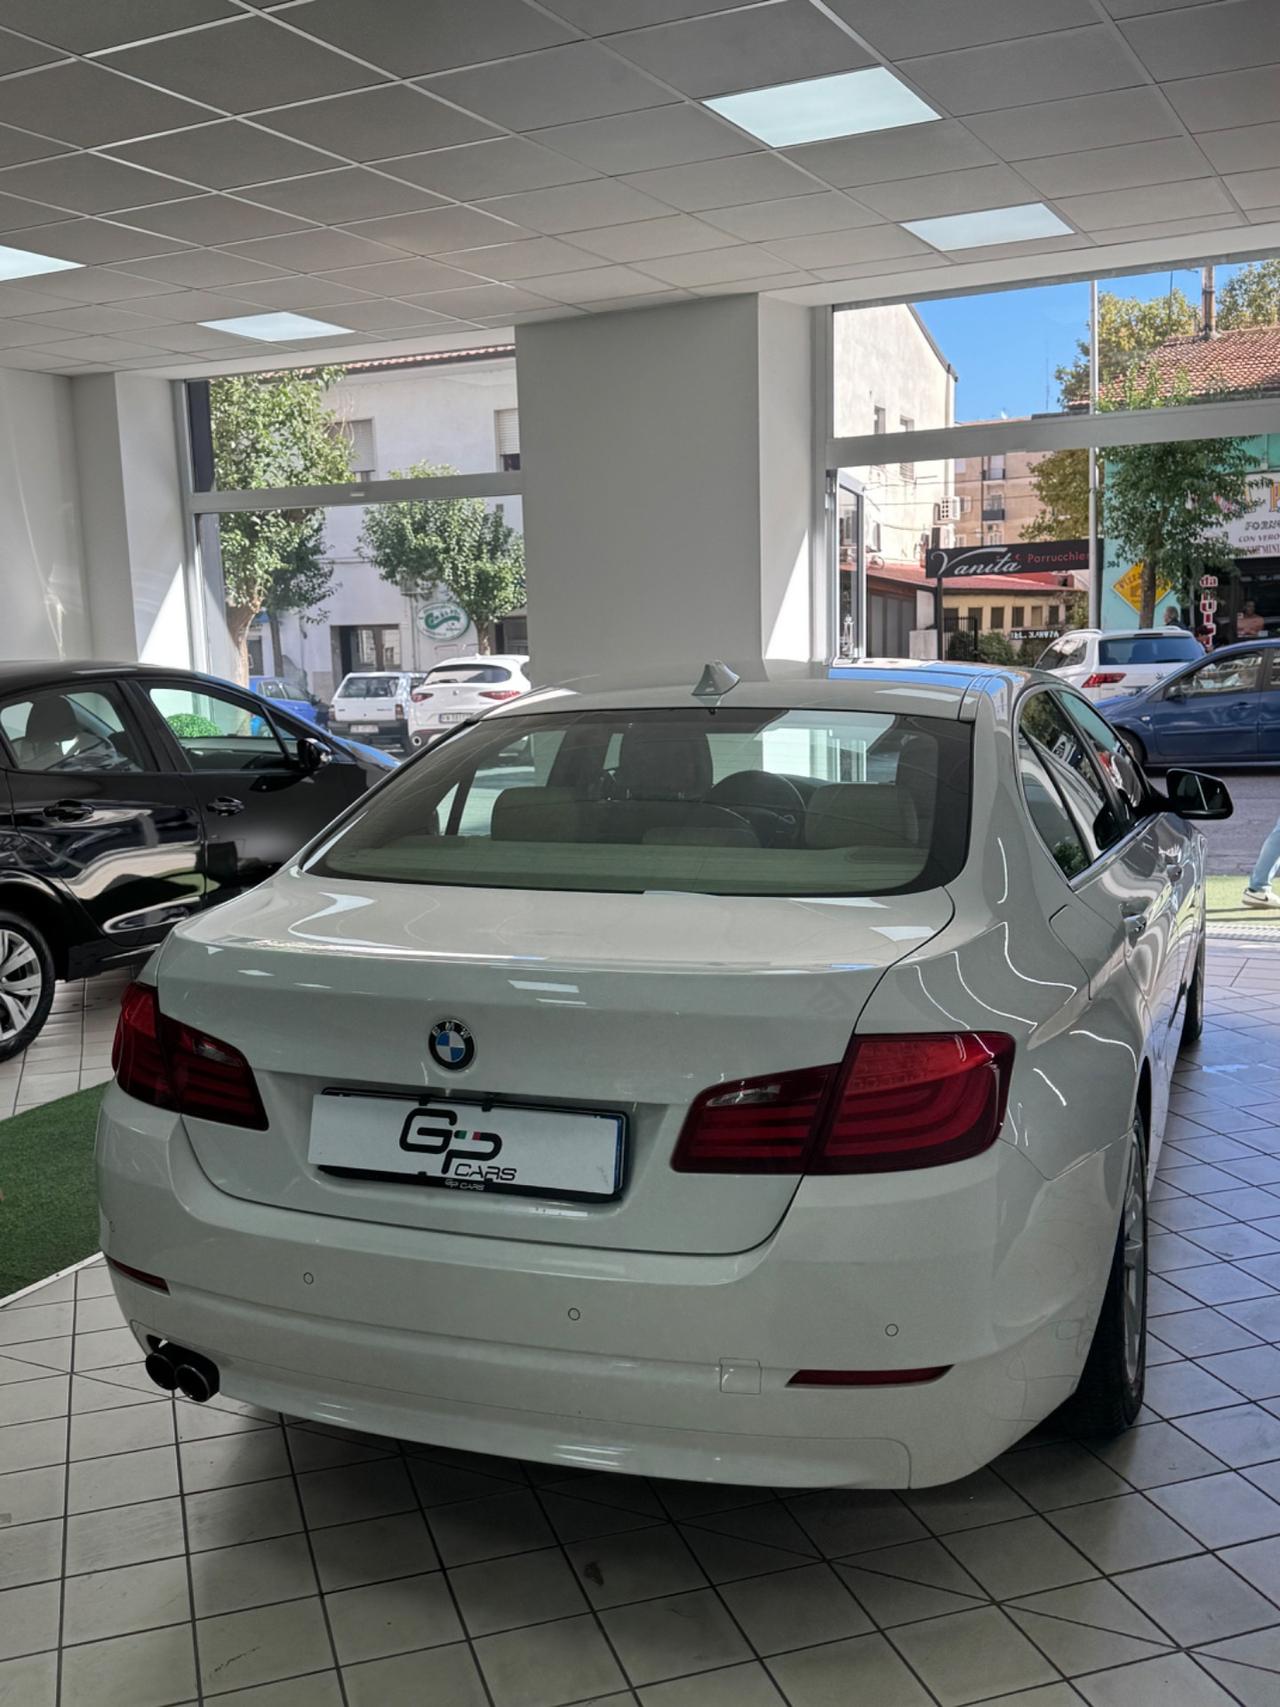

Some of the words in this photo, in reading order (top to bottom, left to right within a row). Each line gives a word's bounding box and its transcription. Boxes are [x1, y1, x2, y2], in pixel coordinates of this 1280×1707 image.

[1238, 535, 1256, 543] CON
[1200, 575, 1218, 587] da
[399, 1107, 503, 1175] GP
[454, 1163, 517, 1181] CARS
[459, 1182, 485, 1191] CARS
